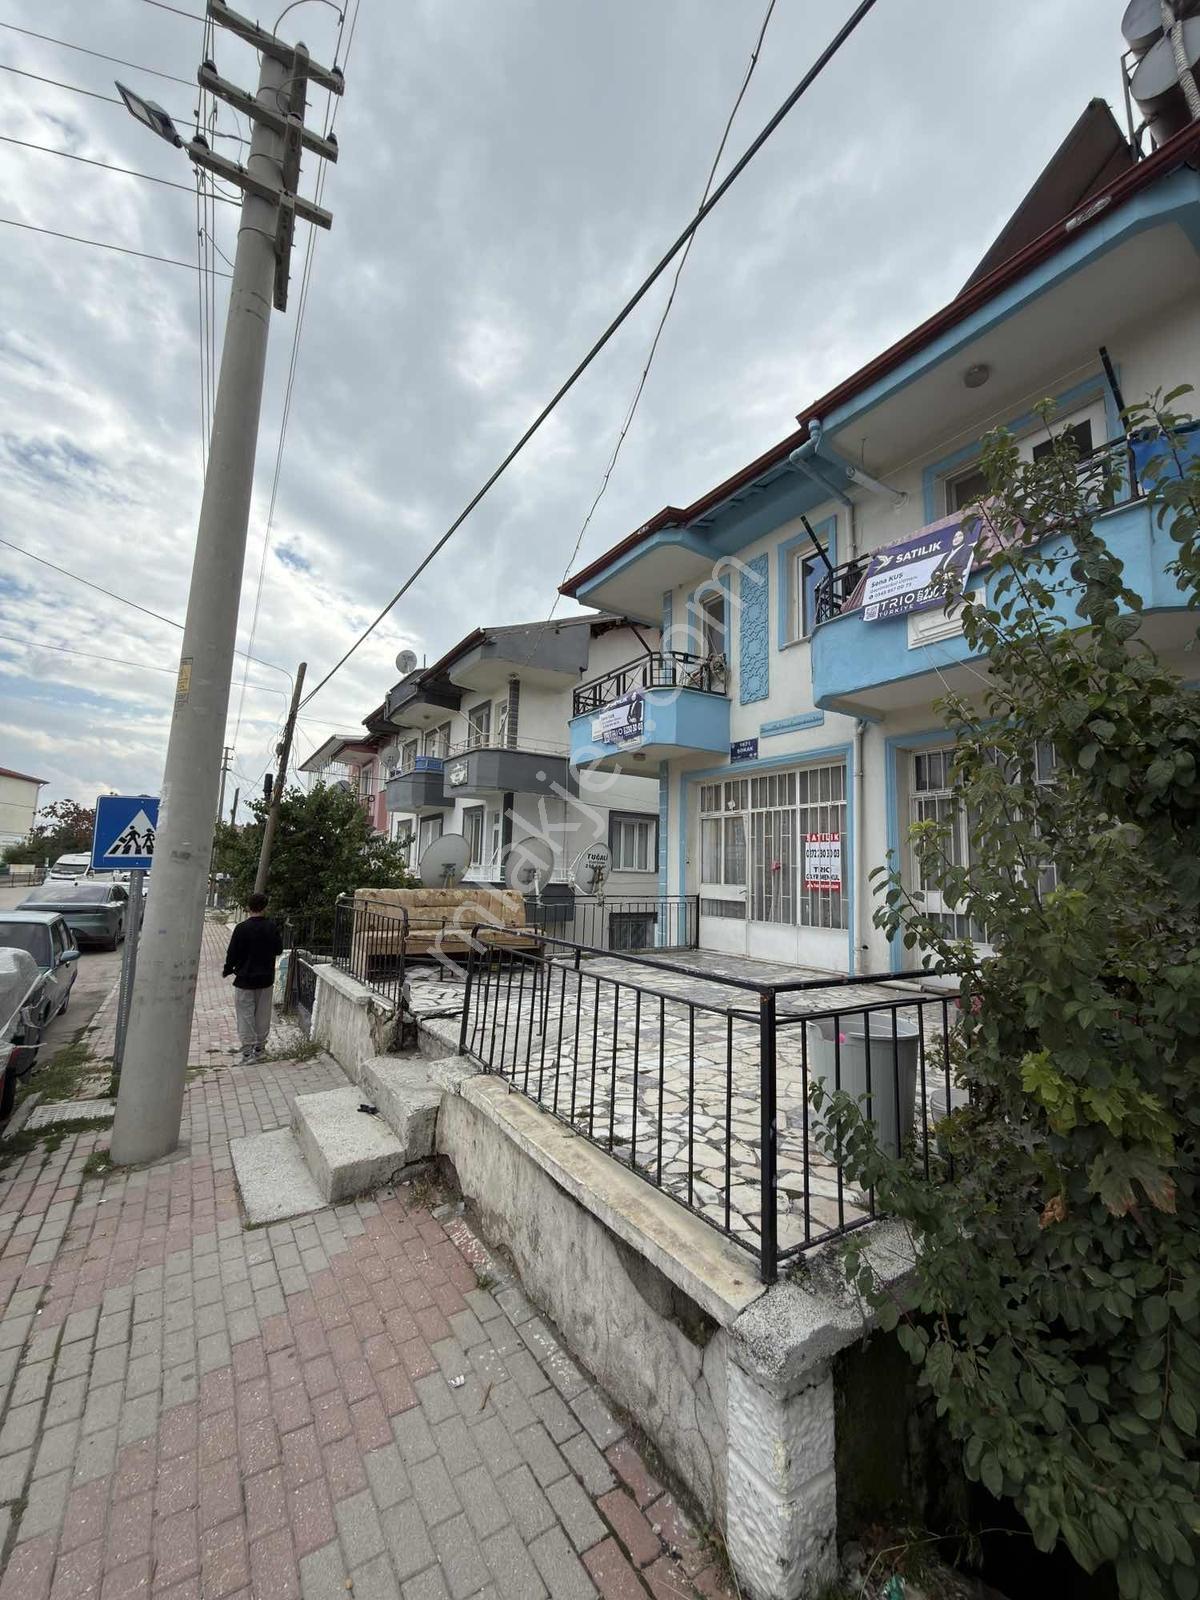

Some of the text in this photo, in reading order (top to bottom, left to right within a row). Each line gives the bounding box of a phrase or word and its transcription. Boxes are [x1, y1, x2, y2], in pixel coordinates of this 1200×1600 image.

[895, 541, 941, 563] SATILIK
[881, 593, 915, 610] TRIO
[879, 604, 914, 619] TÜRKİYE
[806, 833, 839, 841] SATILIK
